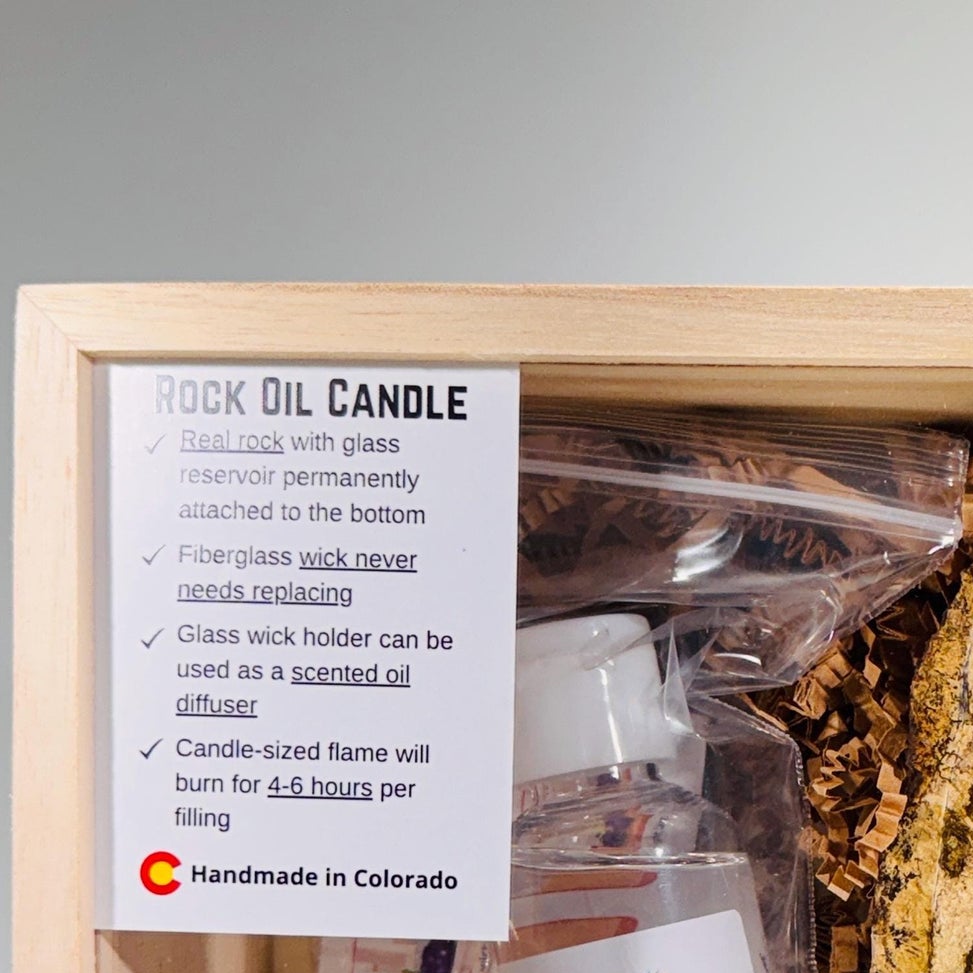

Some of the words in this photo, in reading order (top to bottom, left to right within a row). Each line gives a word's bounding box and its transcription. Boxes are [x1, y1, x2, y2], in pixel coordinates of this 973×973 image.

[180, 430, 230, 451] Real
[239, 431, 284, 452] rock
[291, 432, 335, 452] with
[343, 433, 400, 456] glass
[179, 466, 276, 486] reservoir
[283, 469, 420, 494] permanently
[178, 501, 273, 521] attached
[281, 504, 301, 522] to
[308, 504, 343, 523] the
[351, 505, 426, 525] bottom
[178, 544, 292, 570] Fiberglass
[300, 547, 348, 568] wick
[355, 552, 418, 570] never
[178, 580, 244, 600] needs
[252, 582, 353, 607] replacing
[177, 624, 241, 645] Glass
[247, 626, 296, 646] wick
[303, 627, 372, 648] holder
[379, 632, 419, 649] can
[426, 630, 454, 650] be
[176, 660, 230, 679] used
[237, 664, 264, 680] as
[271, 665, 285, 681] a
[291, 664, 378, 684] scented
[386, 665, 411, 685] oil
[176, 694, 258, 715] diffuser
[176, 738, 320, 761] Candle-sized
[328, 741, 389, 763] flame
[395, 744, 431, 764] will
[175, 774, 224, 793] burn
[232, 775, 261, 794] for
[267, 776, 303, 795] 4-6
[311, 777, 373, 796] hours
[380, 780, 416, 802] per
[174, 808, 231, 832] filling
[191, 865, 318, 887] Handmade
[325, 868, 346, 887] in
[353, 869, 458, 890] Colorado
